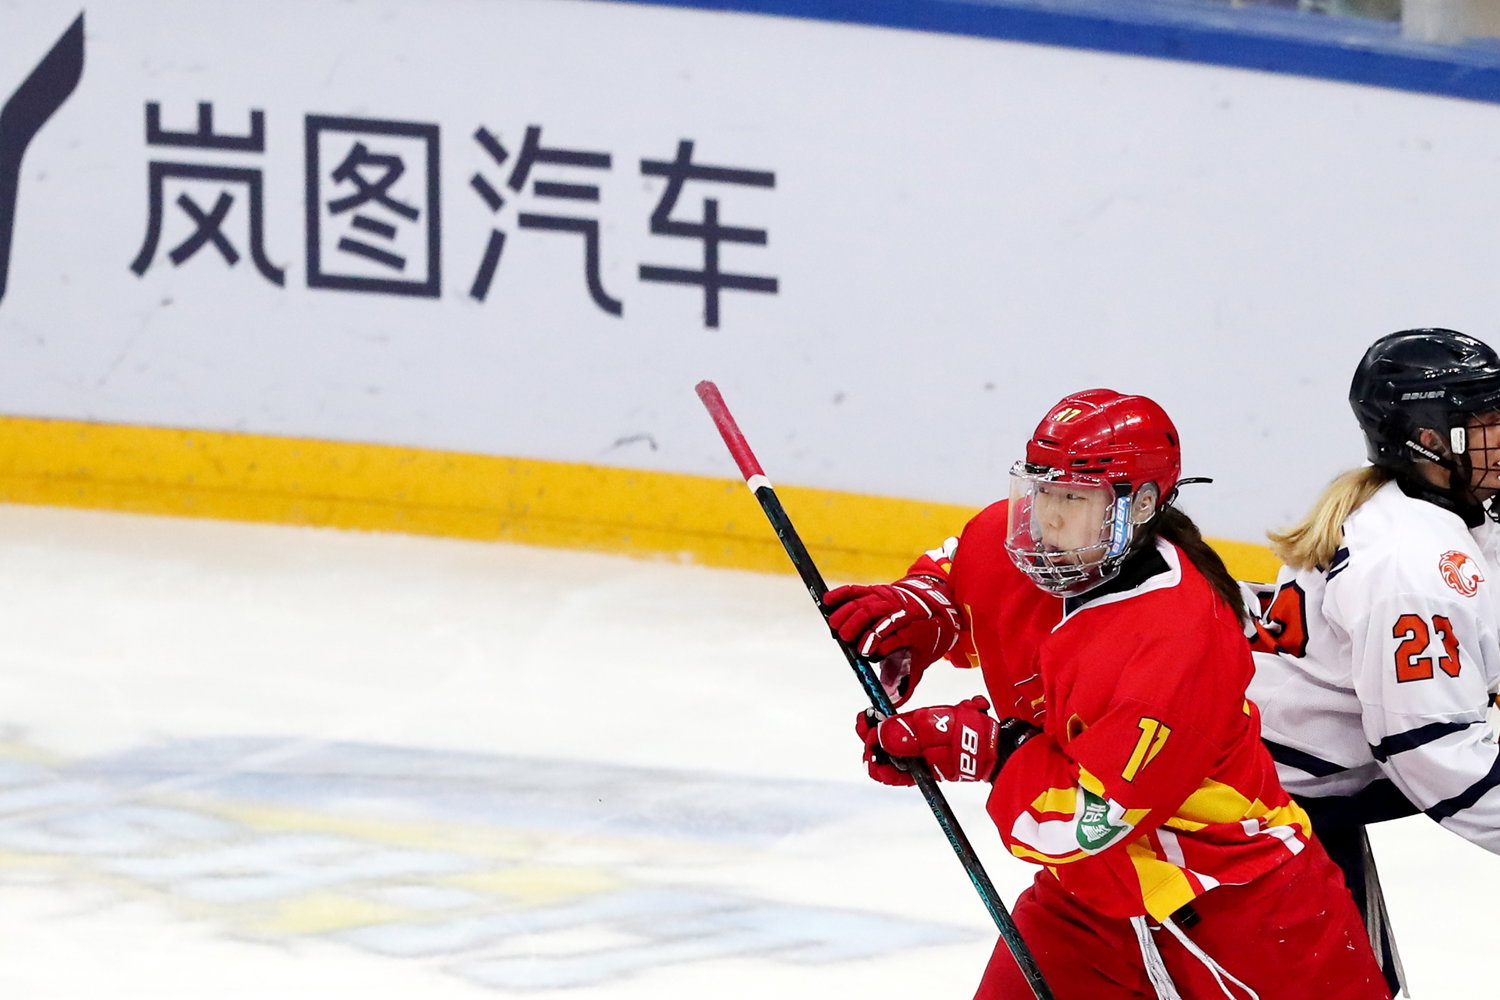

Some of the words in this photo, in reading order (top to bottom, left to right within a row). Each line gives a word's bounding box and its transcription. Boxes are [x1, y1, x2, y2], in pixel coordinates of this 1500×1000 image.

[130, 100, 780, 328] 岚图汽车
[1392, 613, 1461, 684] 23
